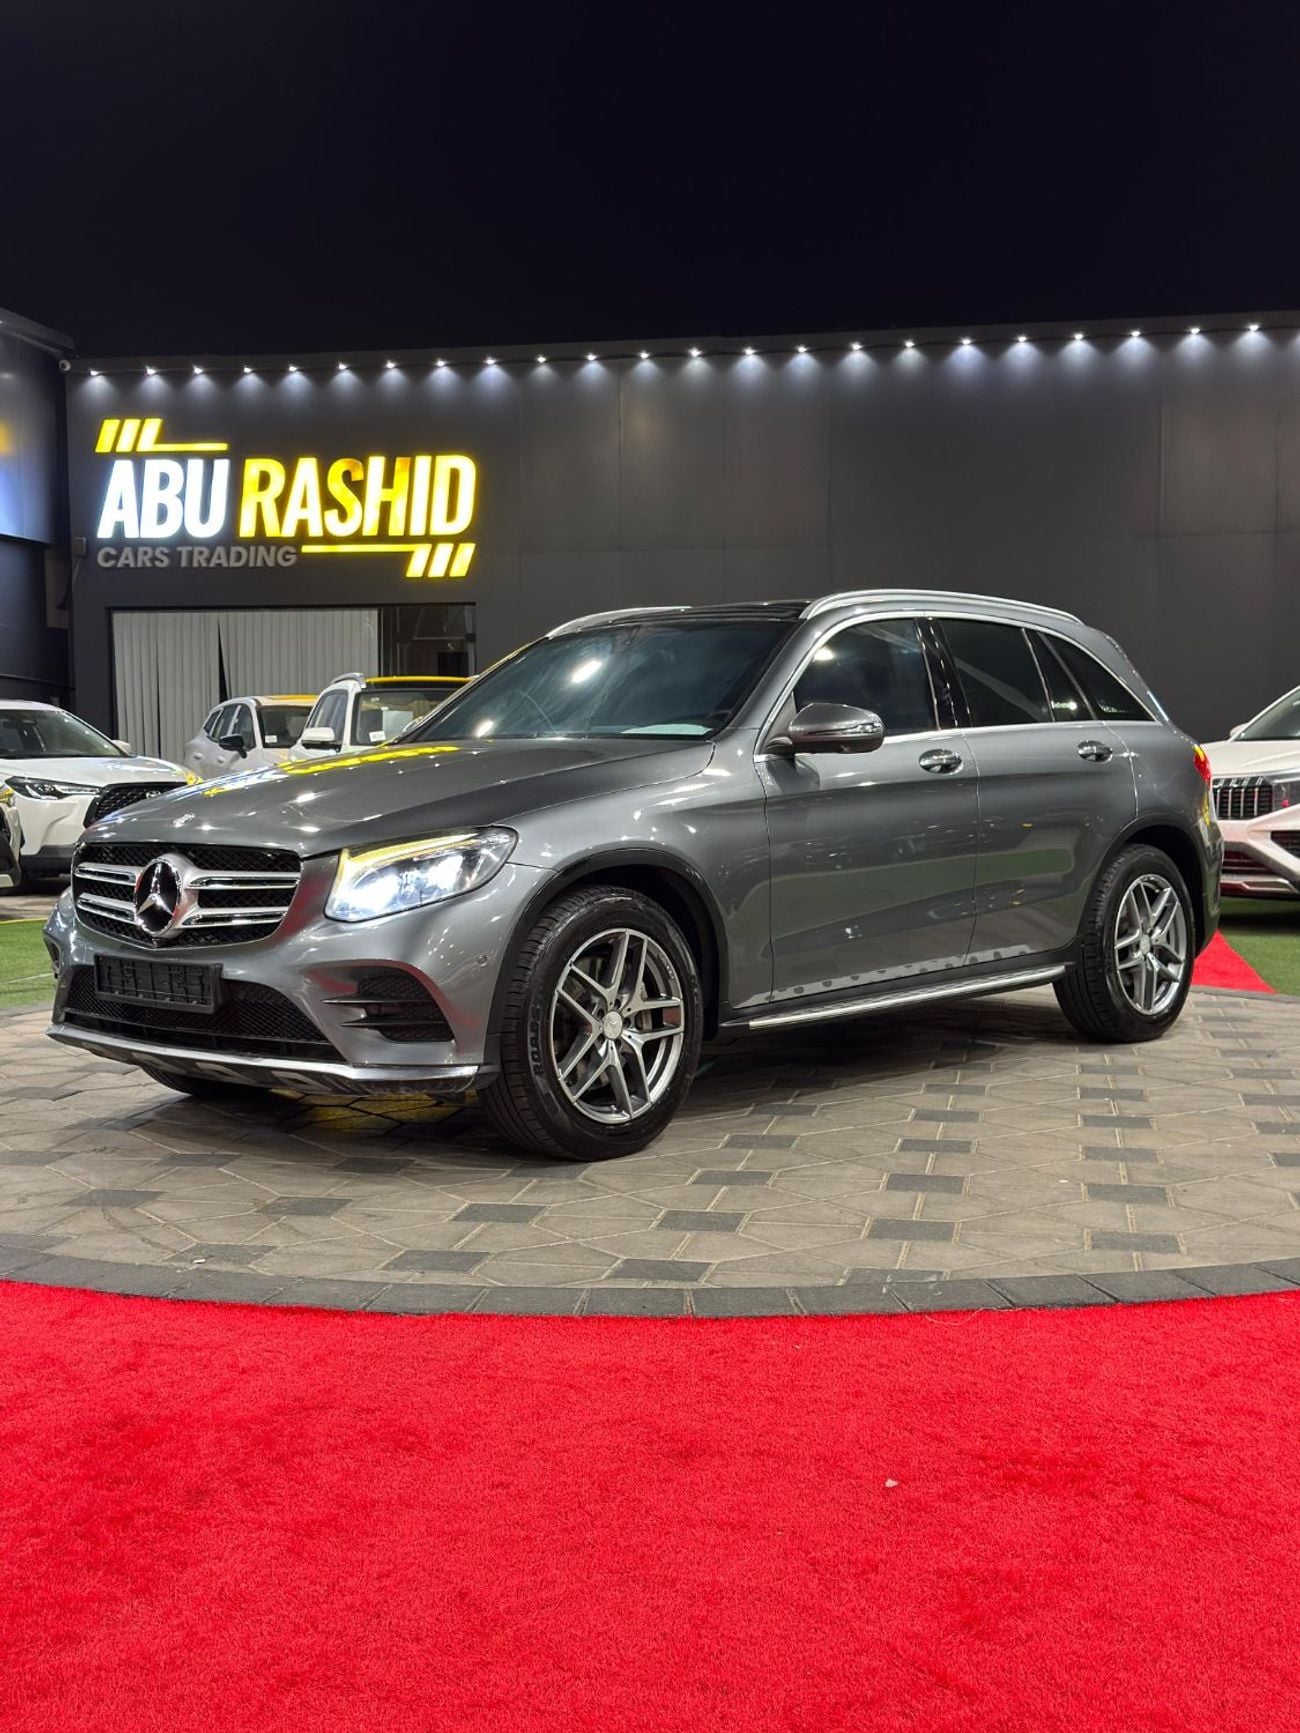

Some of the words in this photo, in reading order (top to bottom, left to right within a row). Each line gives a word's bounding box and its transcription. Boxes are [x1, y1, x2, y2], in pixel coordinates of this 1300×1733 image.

[97, 458, 230, 538] ABU
[239, 455, 477, 537] RASHID
[96, 546, 170, 568] CARS
[176, 545, 298, 568] TRADING
